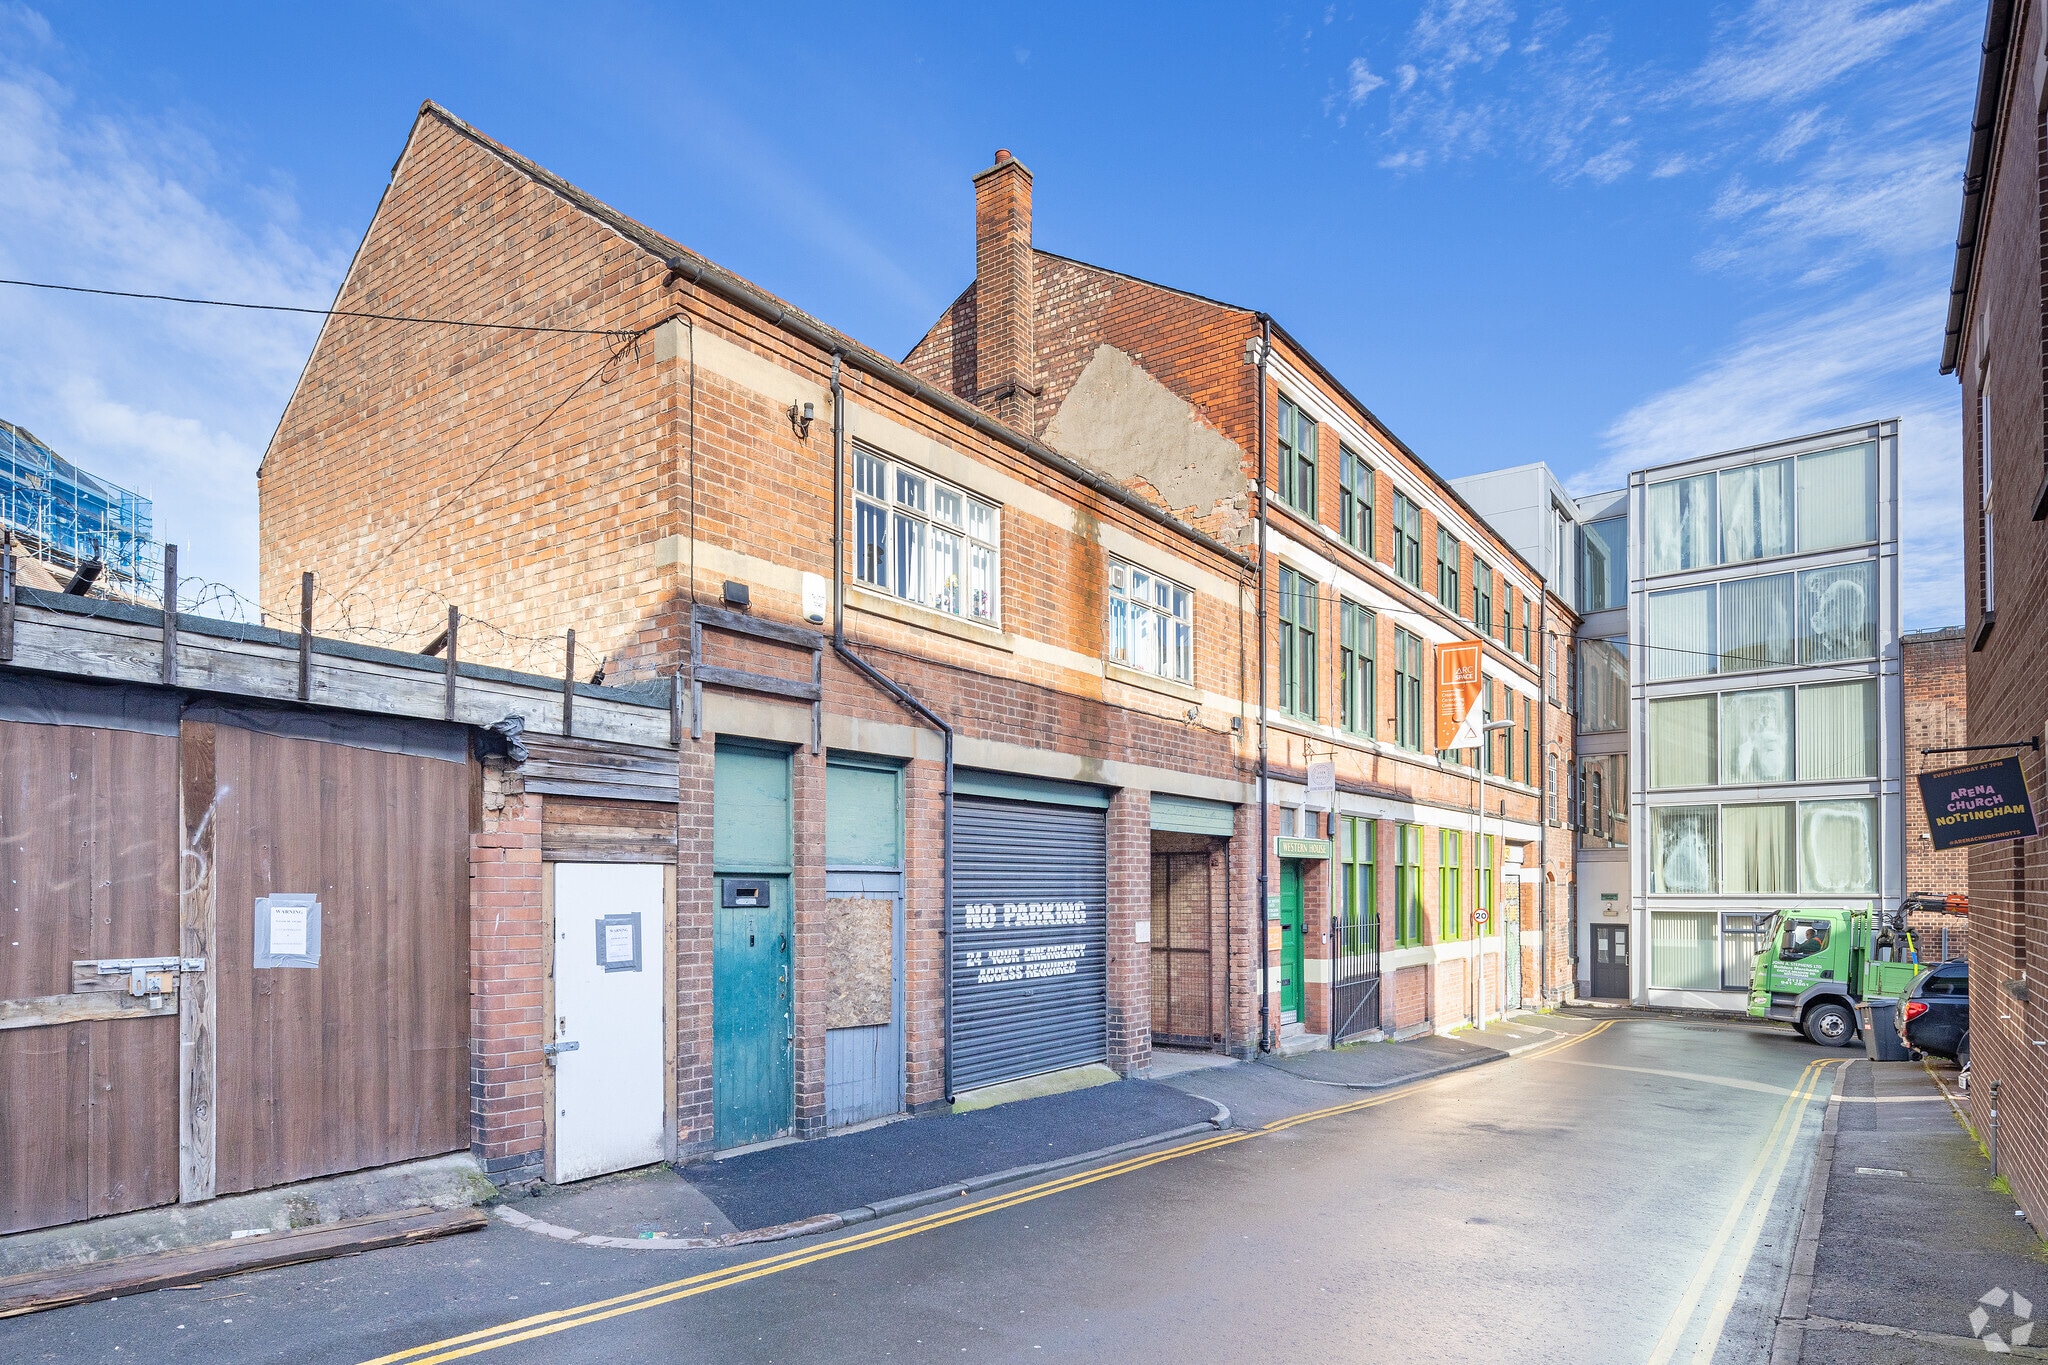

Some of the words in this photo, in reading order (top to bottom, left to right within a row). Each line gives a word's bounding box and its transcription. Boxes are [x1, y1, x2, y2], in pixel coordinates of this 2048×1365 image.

[1455, 666, 1474, 675] ARC
[1455, 673, 1473, 681] SPACE
[1933, 770, 1953, 779] EVERY
[1953, 766, 1979, 775] SUNDAY
[1989, 761, 2004, 769] 7PM
[1950, 785, 1996, 801] ARENA
[1947, 794, 2004, 812] CHURCH
[1935, 804, 2026, 826] NOTTINGHAM
[1949, 829, 2022, 846] @ARENACHURCHNOTTS
[1282, 842, 1308, 853] WESTERN
[1309, 843, 1327, 854] HOUSE
[965, 902, 997, 929] NO
[1003, 901, 1087, 927] PARKING
[1475, 912, 1487, 920] 20
[966, 952, 983, 967] 24
[987, 949, 1020, 965] HOUR
[1023, 943, 1087, 962] EMERGENCY
[977, 964, 1024, 984] ACCESS
[1025, 960, 1077, 978] REQUIRED
